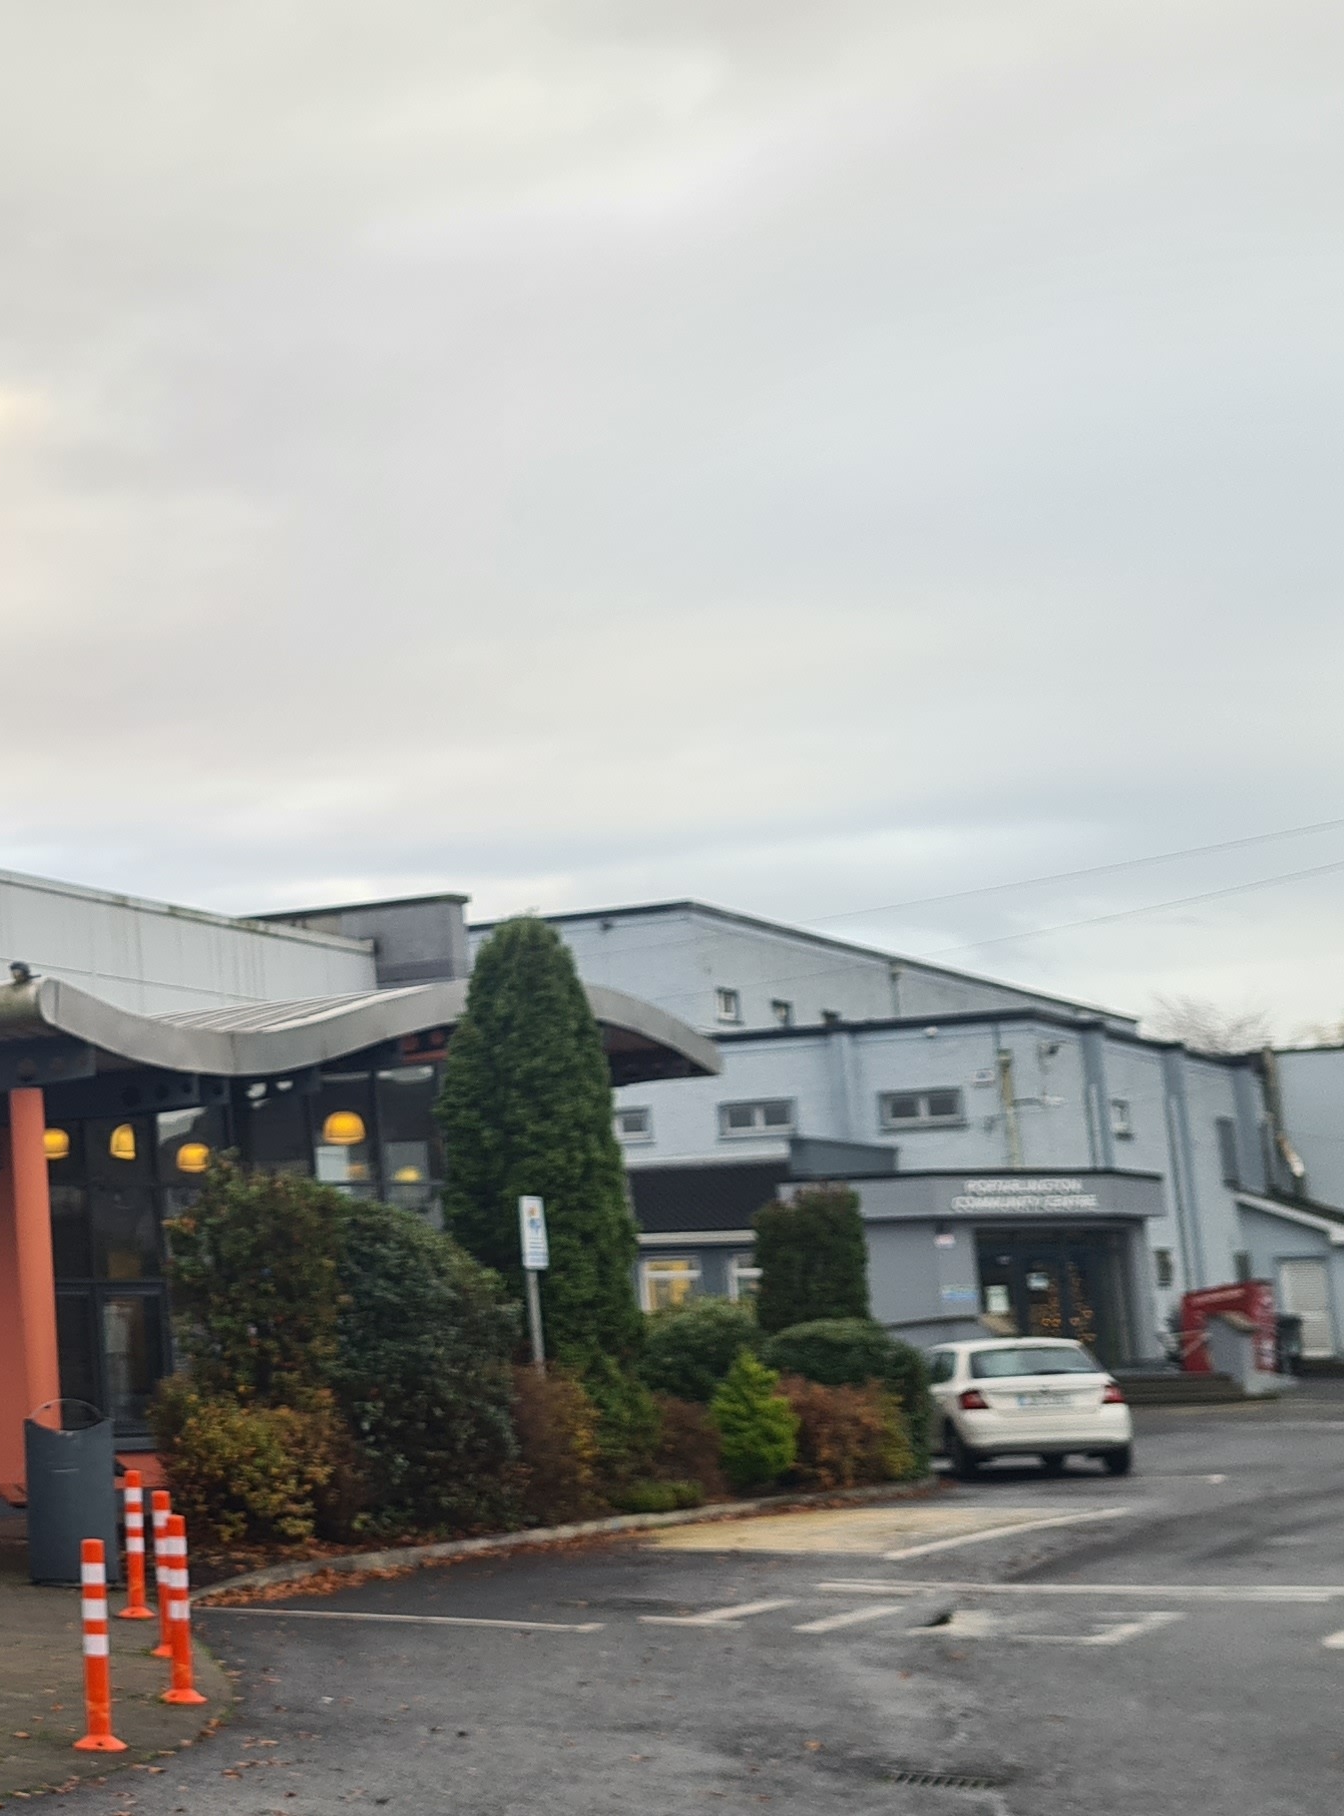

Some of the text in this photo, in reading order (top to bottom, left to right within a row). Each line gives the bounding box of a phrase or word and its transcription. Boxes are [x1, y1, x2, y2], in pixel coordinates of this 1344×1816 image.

[963, 1178, 1083, 1194] PORTARLINGTON
[951, 1194, 1098, 1212] COMMUNITY CENTRE
